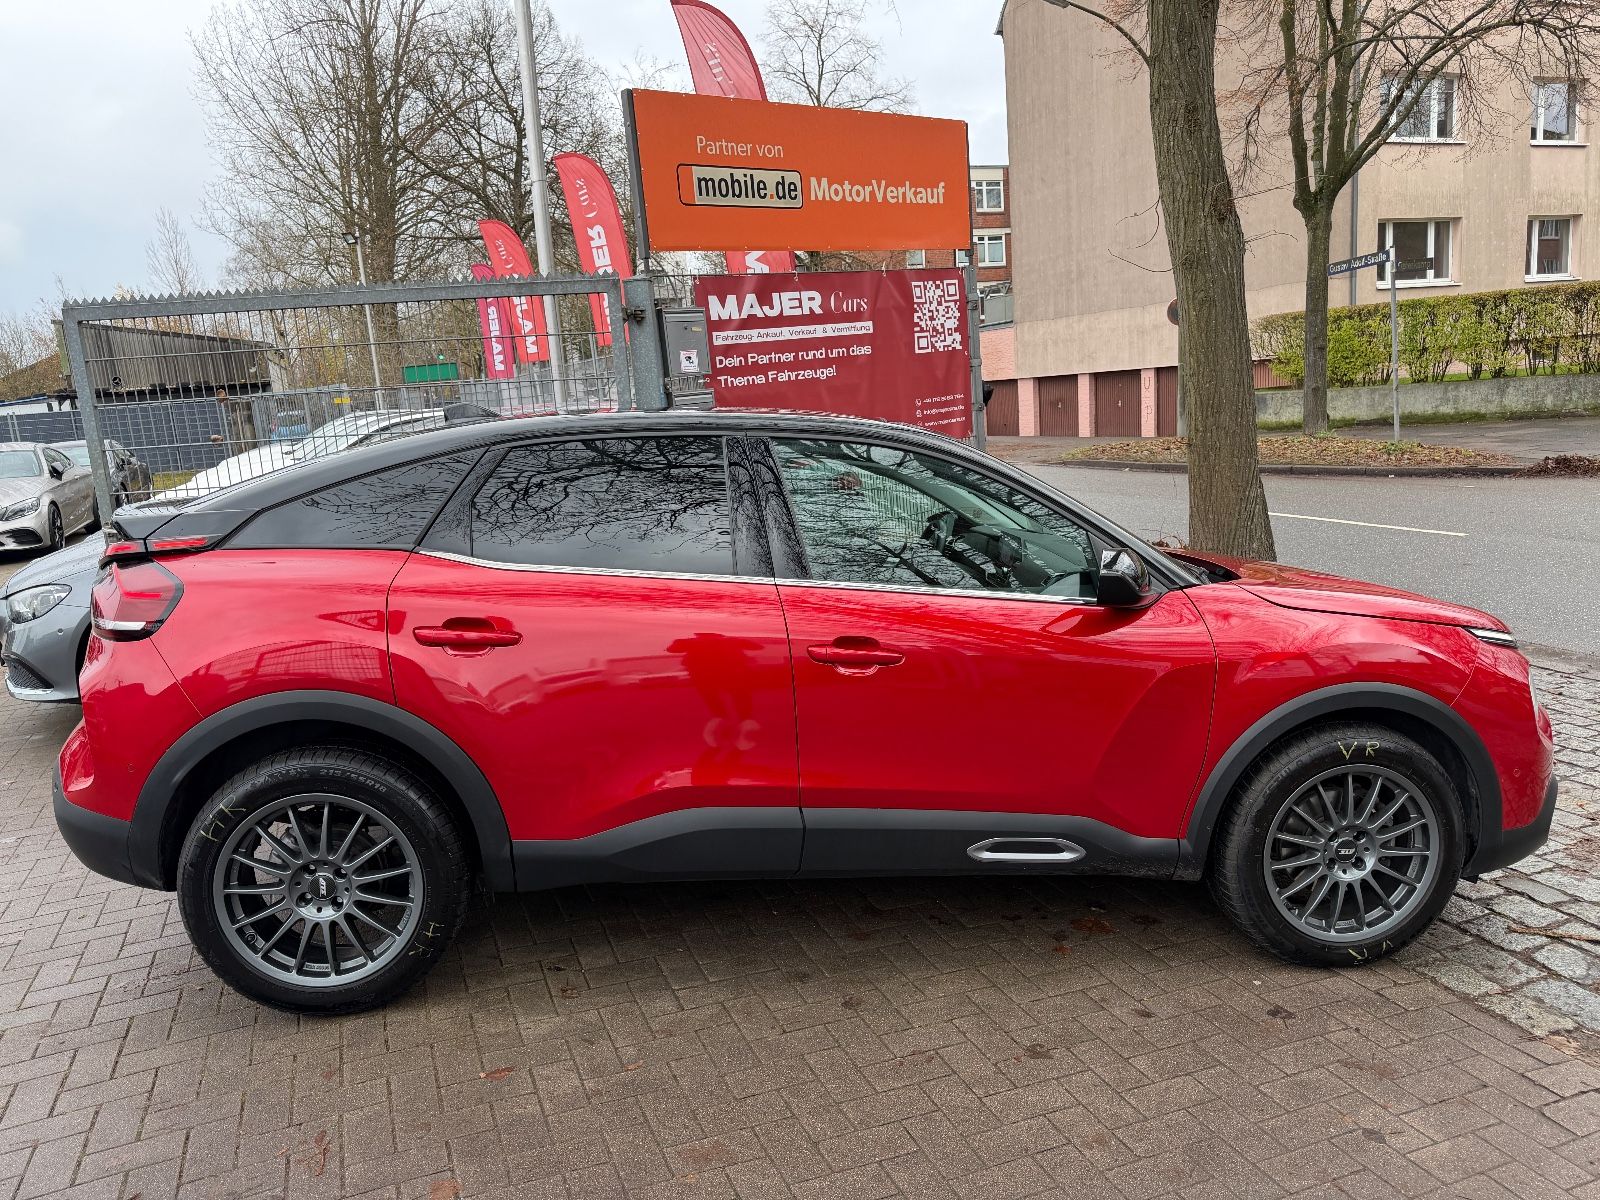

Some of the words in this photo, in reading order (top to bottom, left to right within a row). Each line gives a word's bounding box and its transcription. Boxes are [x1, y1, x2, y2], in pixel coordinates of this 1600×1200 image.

[696, 135, 752, 157] Partner
[756, 143, 784, 158] von
[697, 172, 798, 201] mobile.de
[810, 176, 945, 204] MotorVerkauf
[707, 290, 823, 320] MAJER
[830, 290, 868, 315] Cars
[715, 354, 745, 368] Dein
[748, 351, 797, 366] Partner
[798, 346, 826, 361] rund
[828, 347, 847, 358] um
[849, 344, 872, 356] das
[717, 371, 765, 388] Thema
[768, 364, 837, 383] Fahrzeuge!
